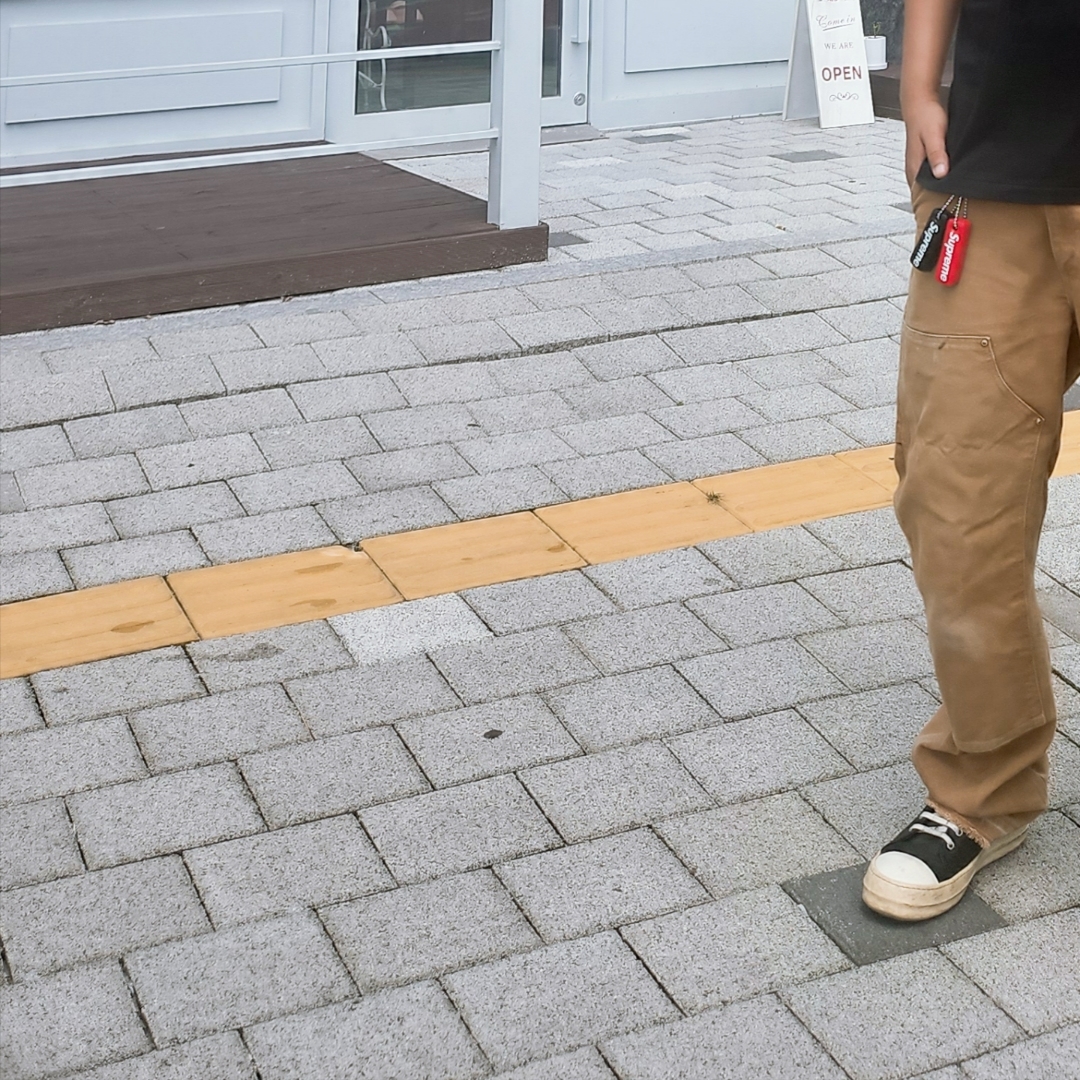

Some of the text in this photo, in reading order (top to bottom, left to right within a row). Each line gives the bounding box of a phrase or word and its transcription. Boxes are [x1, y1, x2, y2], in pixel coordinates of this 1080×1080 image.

[816, 15, 845, 28] Come
[824, 41, 854, 50] WE ARE
[821, 66, 862, 81] OPEN
[912, 221, 939, 268] Supreme
[940, 230, 960, 283] Supreme
